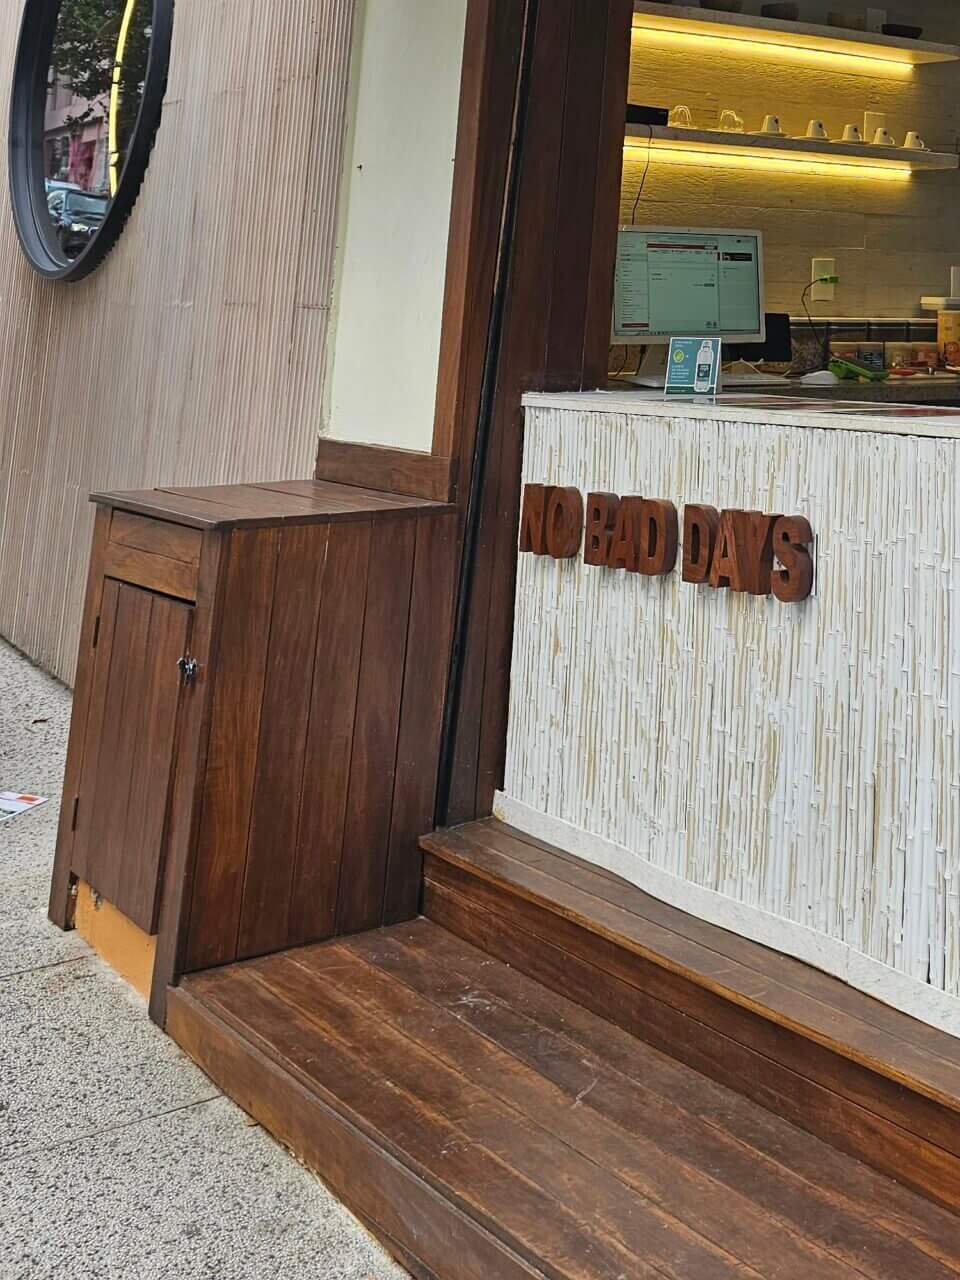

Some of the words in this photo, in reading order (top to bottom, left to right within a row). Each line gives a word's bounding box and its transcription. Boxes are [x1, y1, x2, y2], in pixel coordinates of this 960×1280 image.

[519, 483, 584, 559] NO
[584, 491, 679, 576] BAD
[682, 503, 814, 603] DAYS
